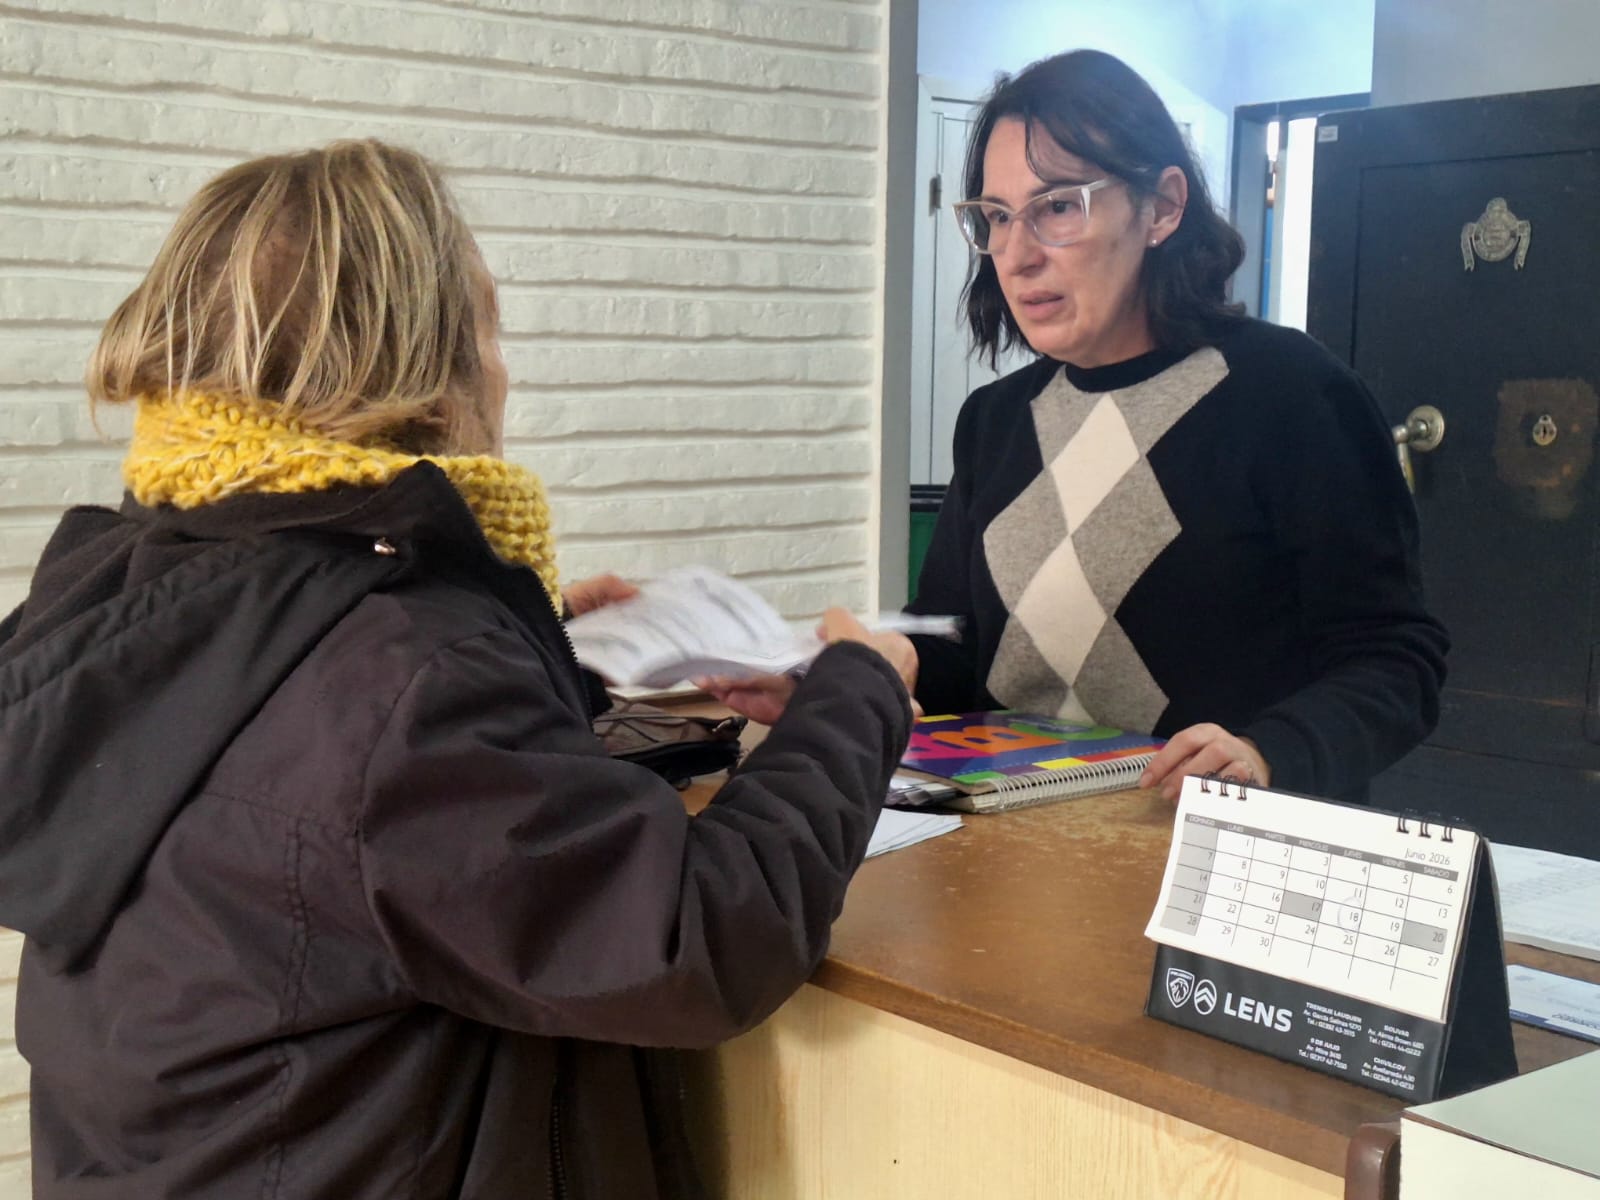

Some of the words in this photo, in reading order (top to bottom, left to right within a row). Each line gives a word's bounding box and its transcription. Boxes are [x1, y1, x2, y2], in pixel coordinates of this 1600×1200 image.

[1283, 847, 1289, 857] 2
[1323, 856, 1329, 866] 3
[1361, 866, 1367, 875] 4
[1402, 875, 1408, 885] 5
[1447, 884, 1453, 894] 6
[1429, 852, 1450, 865] 2026
[1200, 873, 1208, 882] 14
[1233, 882, 1242, 892] 15
[1271, 892, 1281, 902] 16
[1311, 902, 1322, 912] 17
[1349, 911, 1359, 922] 18
[1390, 921, 1400, 932] 19
[1432, 932, 1444, 943] 20
[1208, 851, 1213, 861] 7
[1280, 870, 1285, 879] 9
[1315, 879, 1326, 890] 10
[1354, 888, 1363, 898] 11
[1394, 898, 1405, 908] 12
[1438, 908, 1448, 919] 13
[1187, 915, 1198, 926] 28
[1221, 926, 1232, 935] 29
[1259, 936, 1269, 947] 30
[1193, 894, 1201, 904] 21
[1227, 903, 1237, 914] 22
[1264, 914, 1275, 925] 23
[1305, 925, 1315, 935] 24
[1343, 935, 1354, 946] 25
[1384, 945, 1395, 956] 26
[1427, 956, 1439, 967] 27
[1223, 992, 1293, 1032] LENS
